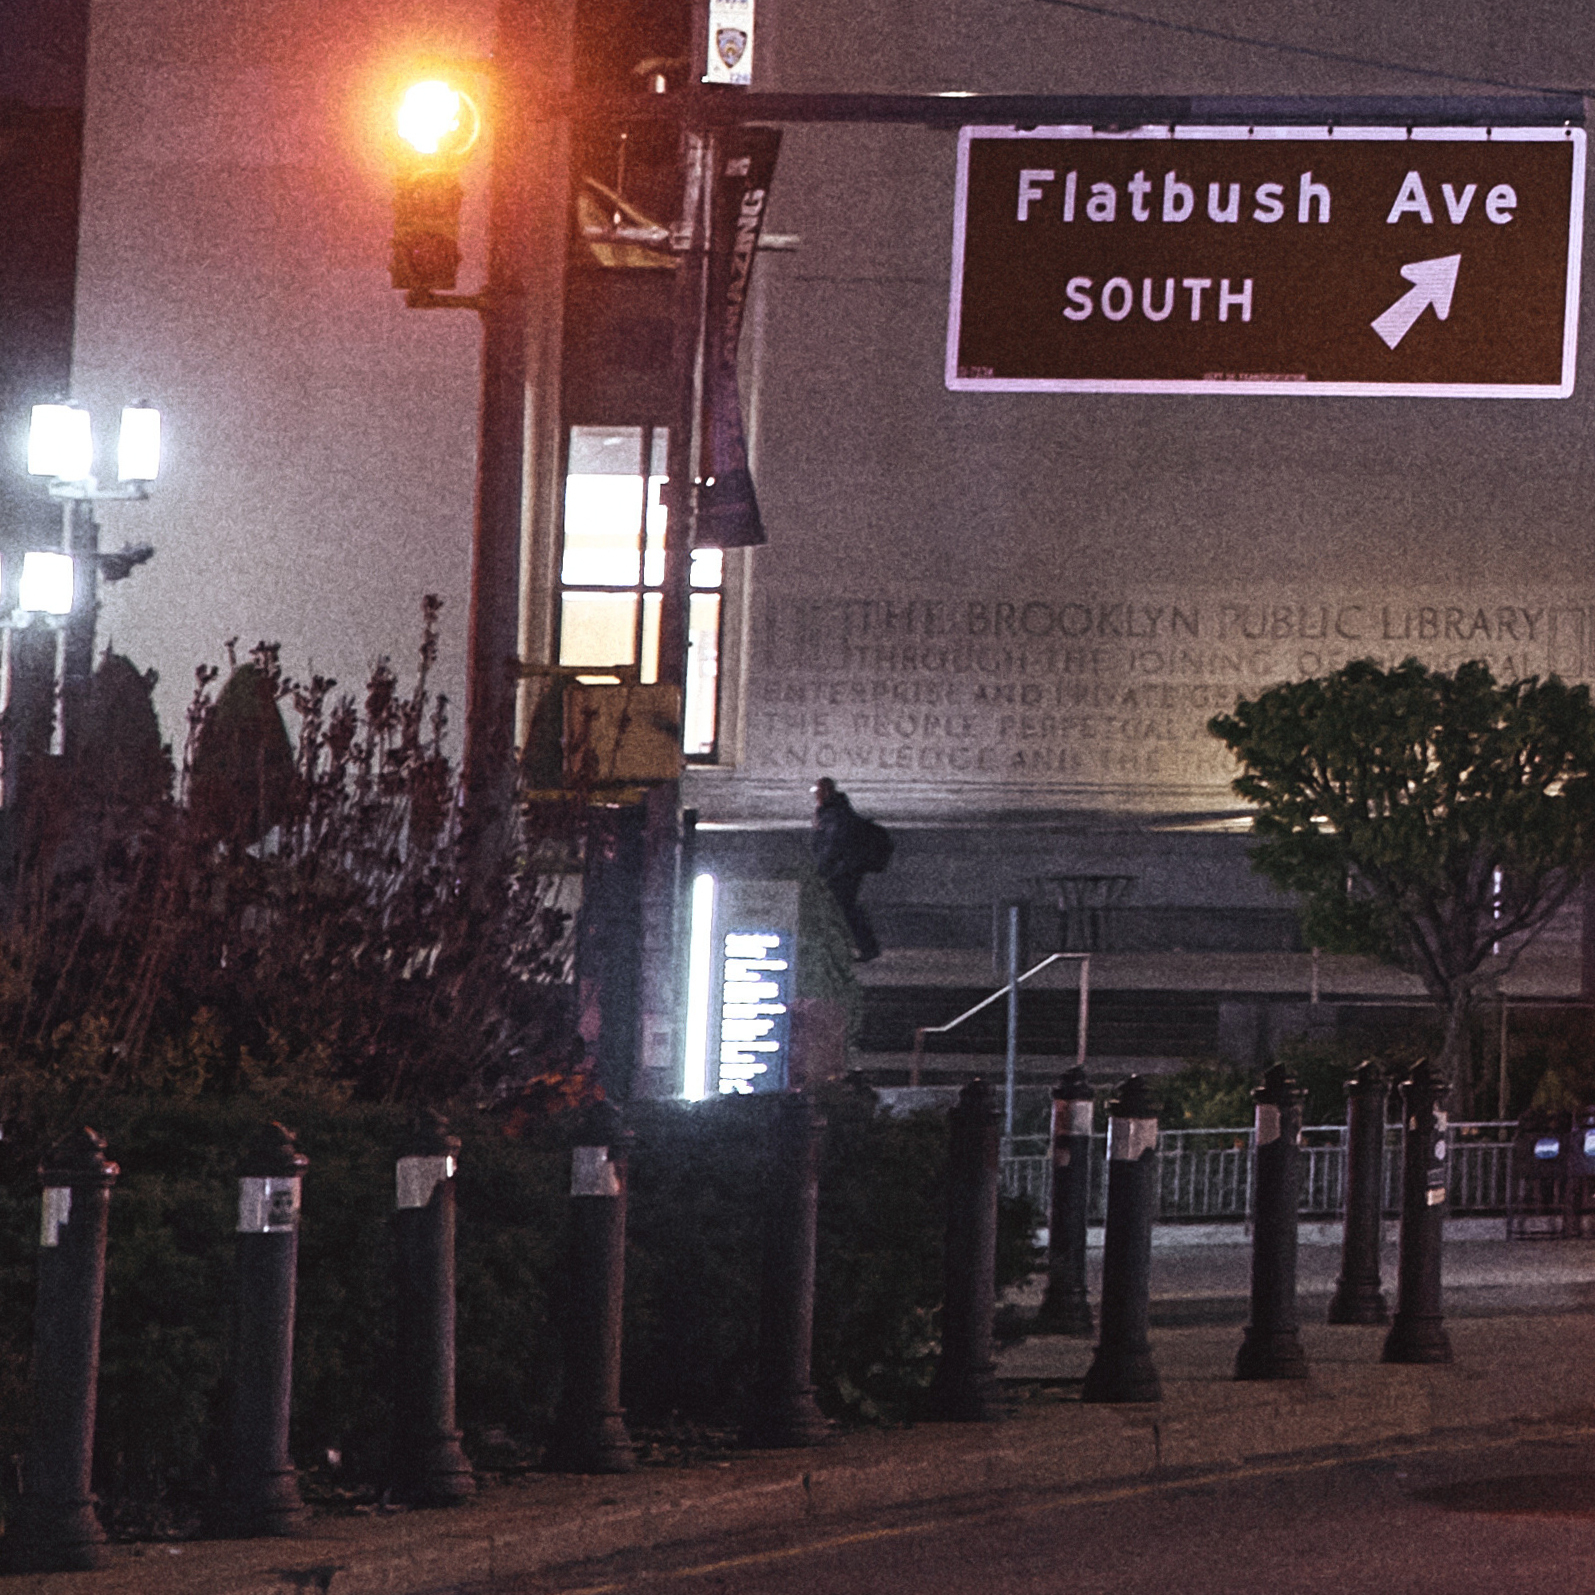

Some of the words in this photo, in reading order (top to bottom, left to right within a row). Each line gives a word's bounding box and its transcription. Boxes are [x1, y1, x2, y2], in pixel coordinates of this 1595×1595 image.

[1016, 168, 1332, 224] Flatbush
[1385, 170, 1518, 225] Ave
[1061, 275, 1255, 323] SOUTH
[854, 600, 942, 637] THE
[966, 601, 1200, 639] BROOKLYN
[1219, 603, 1364, 641] PUBLIC
[1381, 604, 1544, 641] LIBRARY
[1045, 646, 1105, 676] THE
[973, 683, 1044, 708] AND
[765, 712, 828, 737] THE
[851, 713, 973, 739] PEOPLE
[998, 714, 1178, 740] PERPETUAL
[760, 743, 998, 771] KNOWLEDGE
[1011, 746, 1083, 772] AND
[1100, 747, 1162, 774] THE
